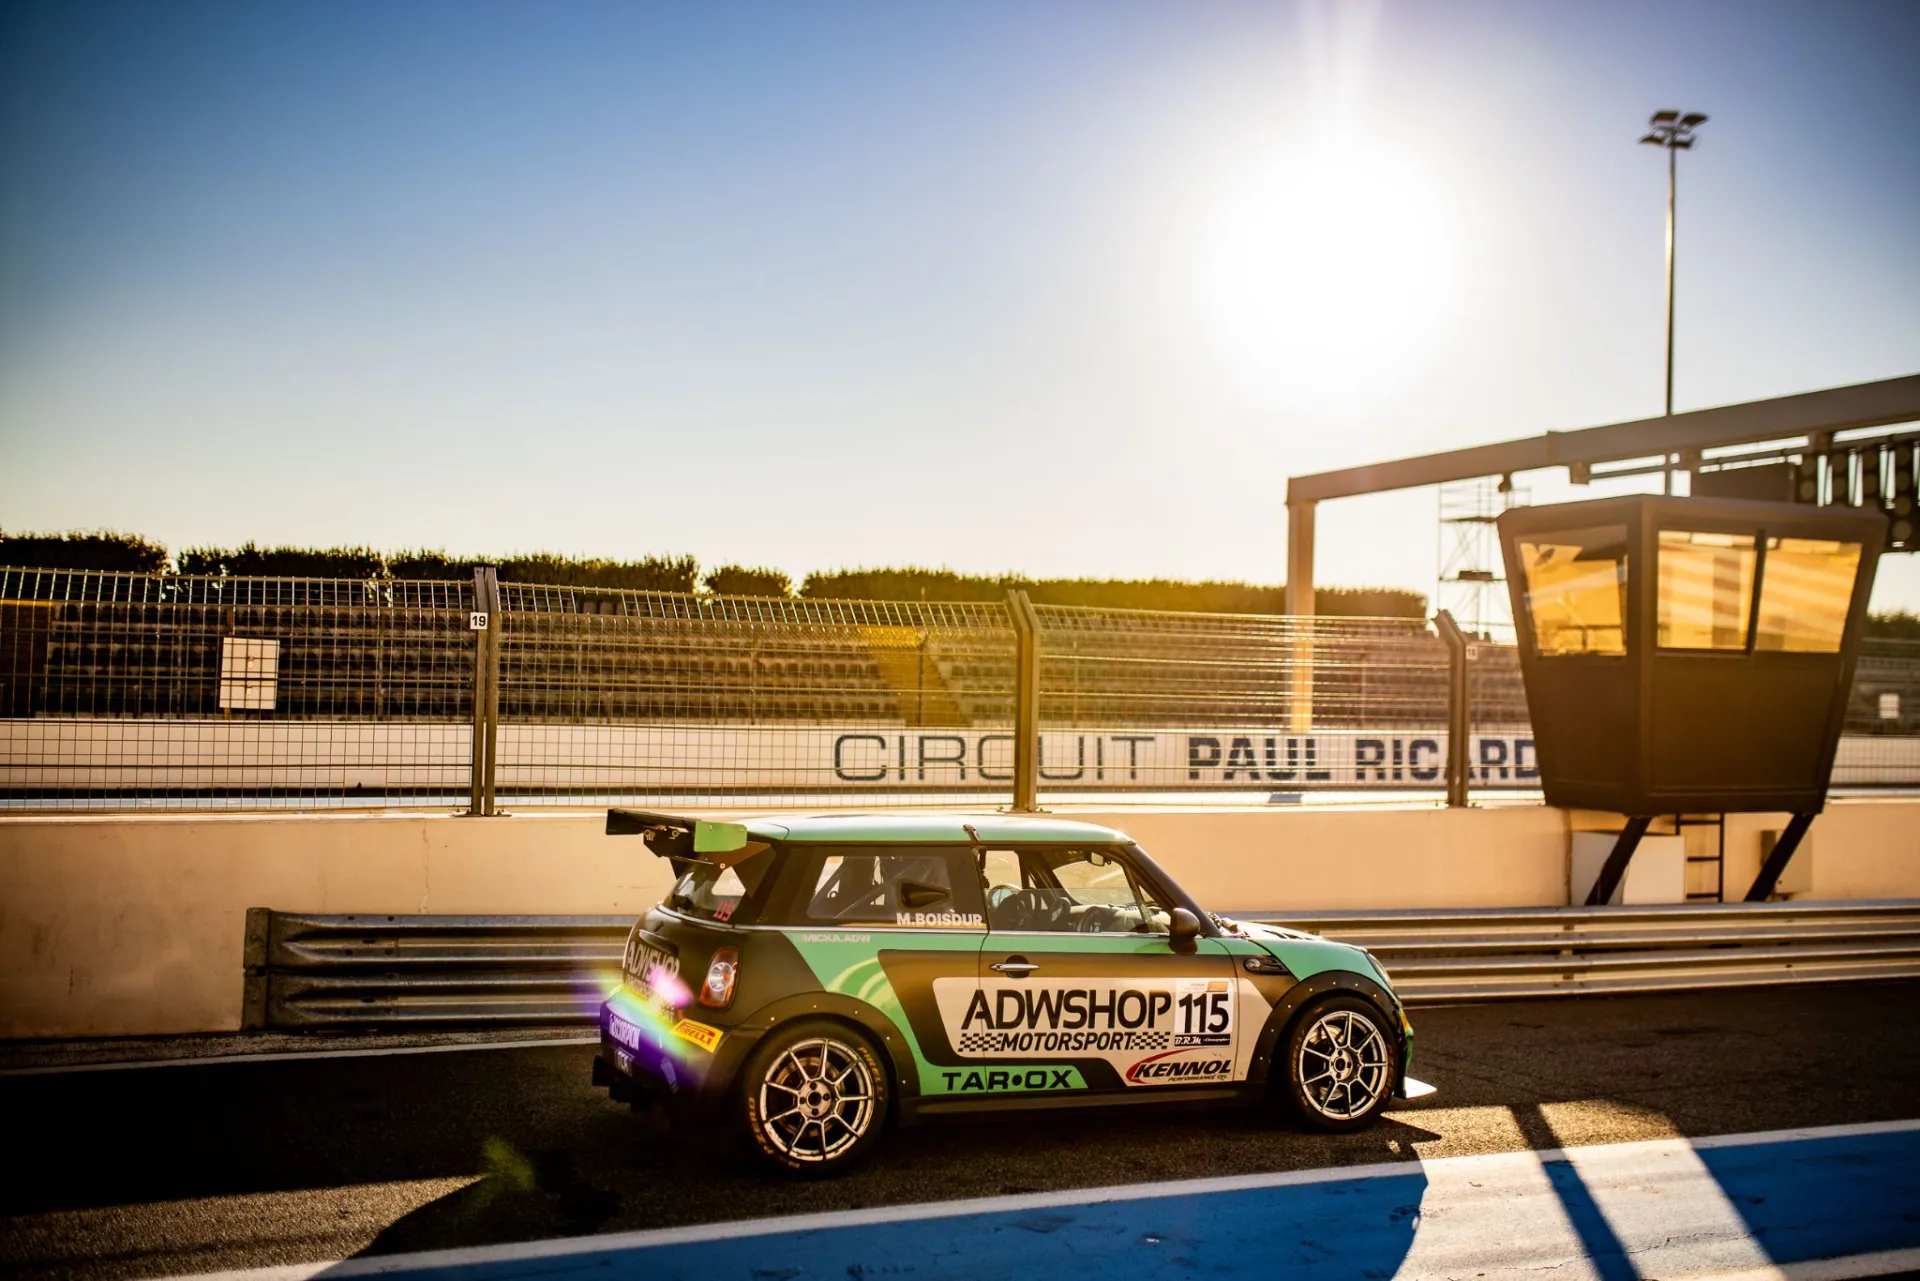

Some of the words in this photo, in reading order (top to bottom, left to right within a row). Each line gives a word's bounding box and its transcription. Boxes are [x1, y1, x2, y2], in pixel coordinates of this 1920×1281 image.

[472, 615, 486, 627] 19
[834, 735, 1155, 782] CIRCUIT
[1188, 737, 1331, 781] PAUL
[1356, 738, 1541, 781] RICRD
[896, 912, 983, 926] M.BOISDUR
[961, 989, 1172, 1030] ADWSHOP
[1178, 993, 1229, 1033] 115
[676, 1021, 716, 1046] PIRELLI
[1001, 1031, 1136, 1052] MOTORSPORT
[1134, 1059, 1232, 1079] KENNOL
